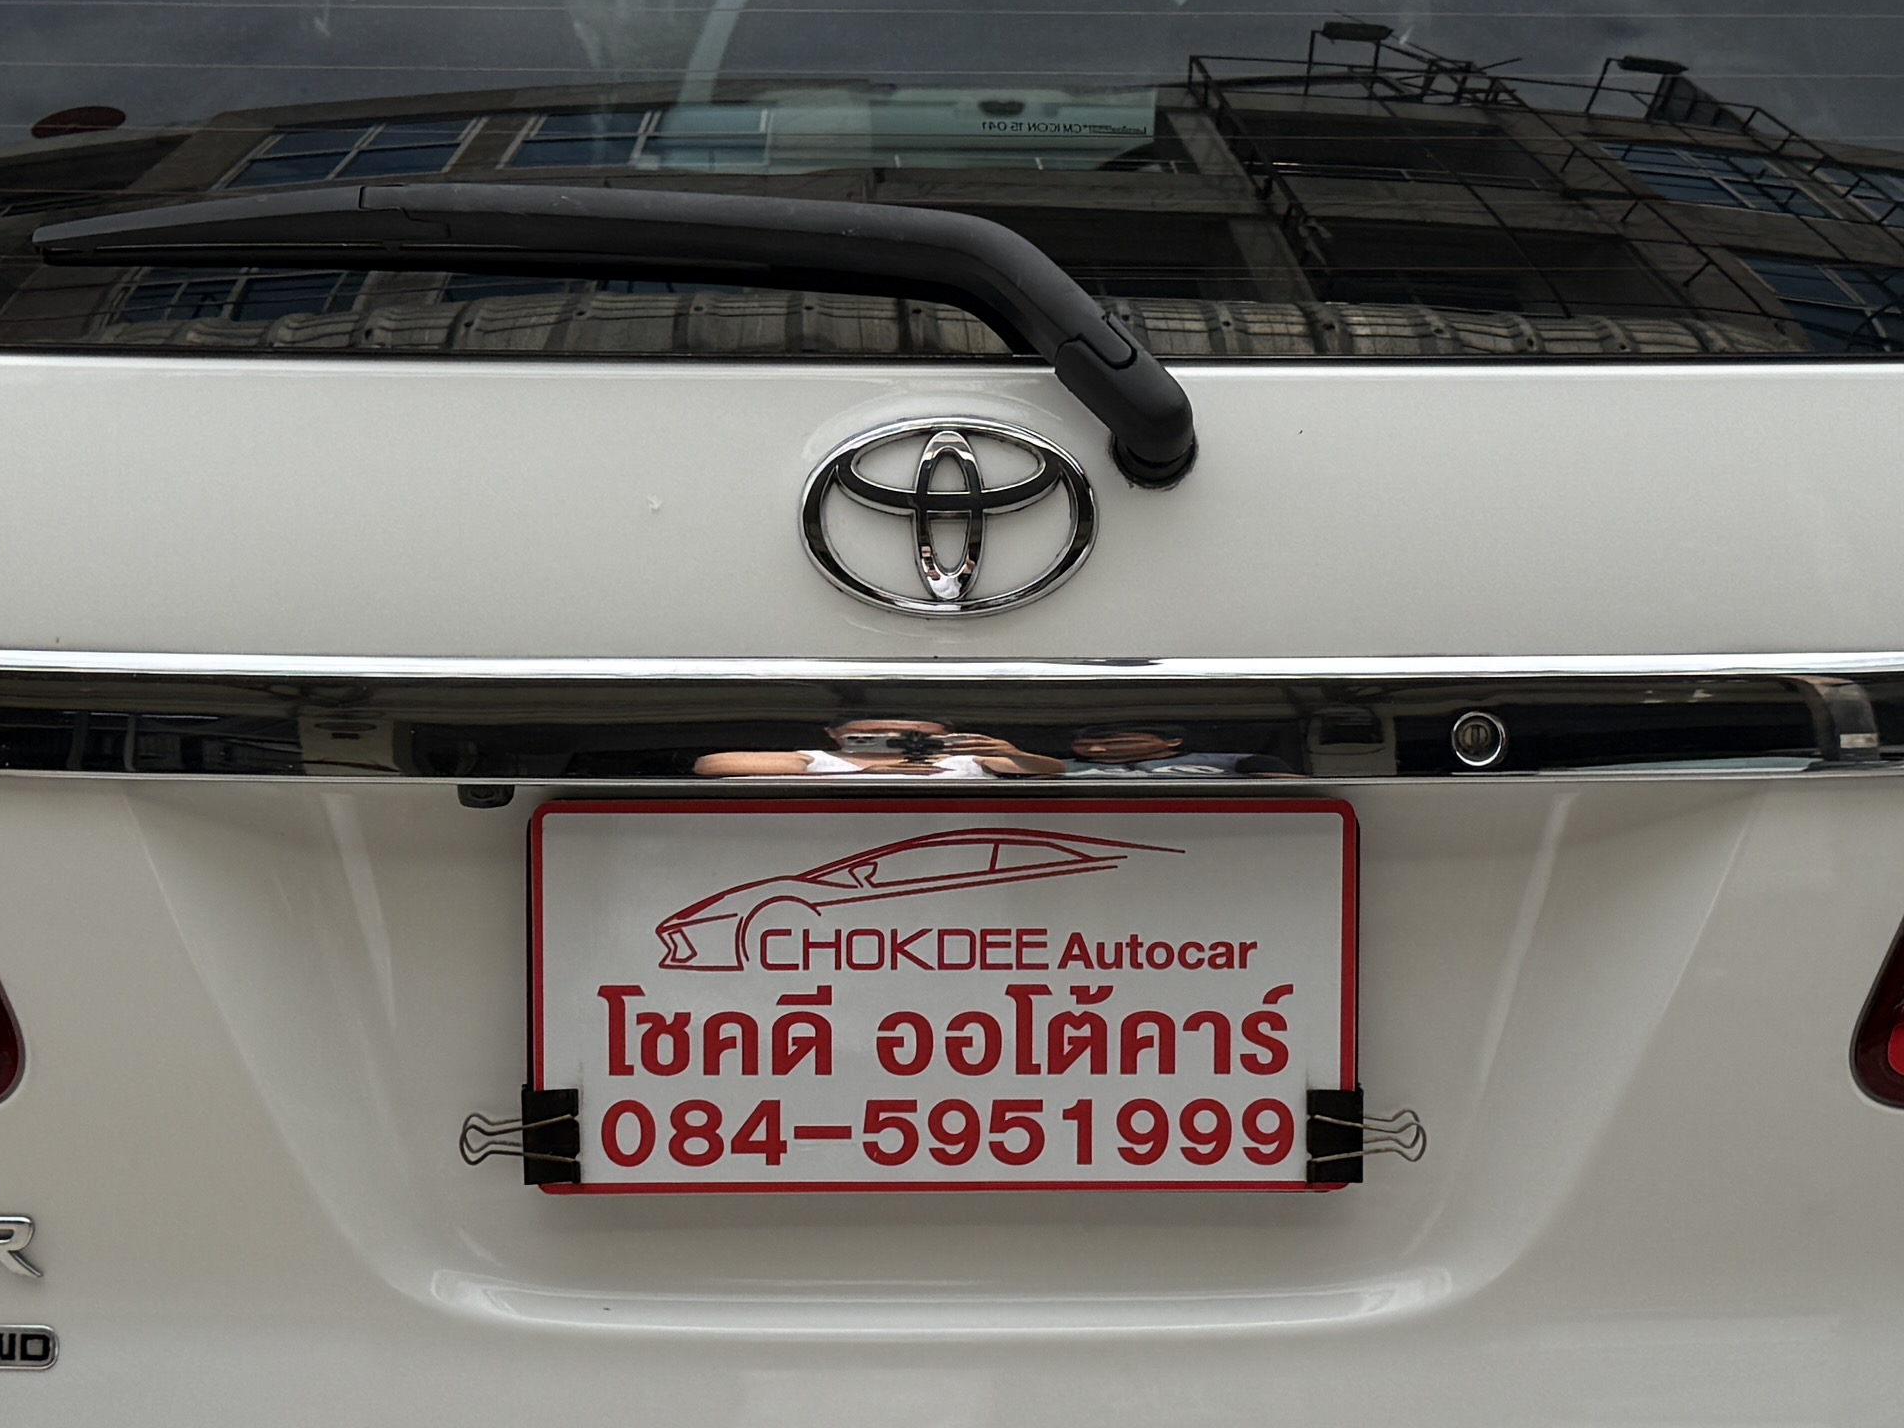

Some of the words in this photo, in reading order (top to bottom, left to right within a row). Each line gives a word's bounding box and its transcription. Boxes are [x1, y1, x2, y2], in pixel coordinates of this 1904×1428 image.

[759, 928, 1048, 971] CHOKDEE
[1056, 932, 1259, 970] Autocar
[597, 984, 834, 1077] โชคดี
[876, 983, 1295, 1077] ออโต้คาร์
[600, 1098, 1296, 1168] 084-5951999
